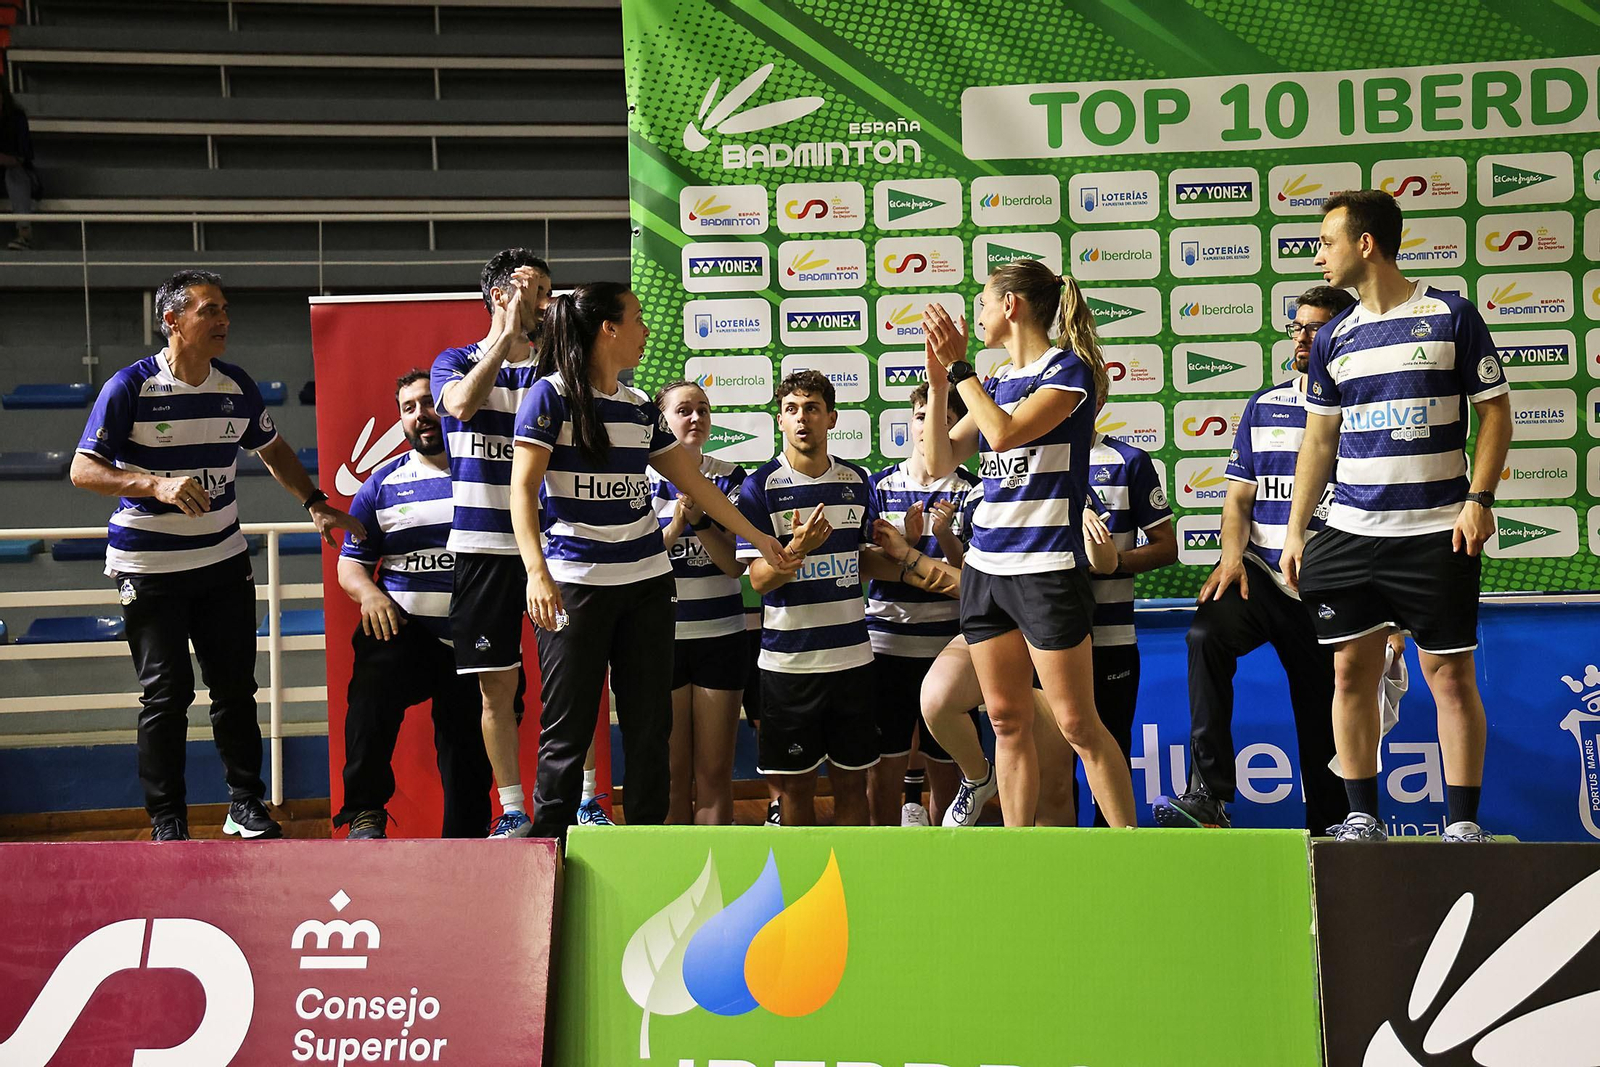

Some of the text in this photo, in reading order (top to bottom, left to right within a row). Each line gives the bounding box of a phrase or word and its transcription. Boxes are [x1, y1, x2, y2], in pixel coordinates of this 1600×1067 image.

[1029, 67, 1600, 148] TOP 10 IBERD
[849, 118, 920, 134] ESPAÑA
[722, 139, 921, 169] BADMINTON
[1101, 191, 1147, 201] LOTERÍAS
[1206, 186, 1247, 199] YONEX
[1002, 195, 1052, 205] Iberdrola
[701, 218, 760, 226] BADMINTON
[1101, 250, 1152, 260] Iberdrola
[1203, 245, 1250, 255] LOTERÍAS
[718, 260, 758, 273] YONEX
[799, 273, 858, 281] BADMINTON
[1202, 303, 1253, 315] Iberdrola
[1500, 305, 1565, 315] BADMINTON
[716, 318, 760, 327] LOTERÍAS
[816, 314, 856, 328] YONEX
[1520, 348, 1563, 362] YONEX
[716, 375, 765, 386] Iberdrola
[825, 372, 858, 381] TERÍAS
[1515, 408, 1564, 419] LOTERÍAS
[827, 430, 863, 440] erdrola
[1392, 428, 1429, 439] original
[472, 434, 513, 460] Hue
[1513, 468, 1568, 479] Iberdrola
[404, 551, 455, 571] Hue
[1585, 739, 1600, 811] PORTUS MARIS
[295, 987, 440, 1028] Consejo
[292, 1028, 448, 1067] Superior
